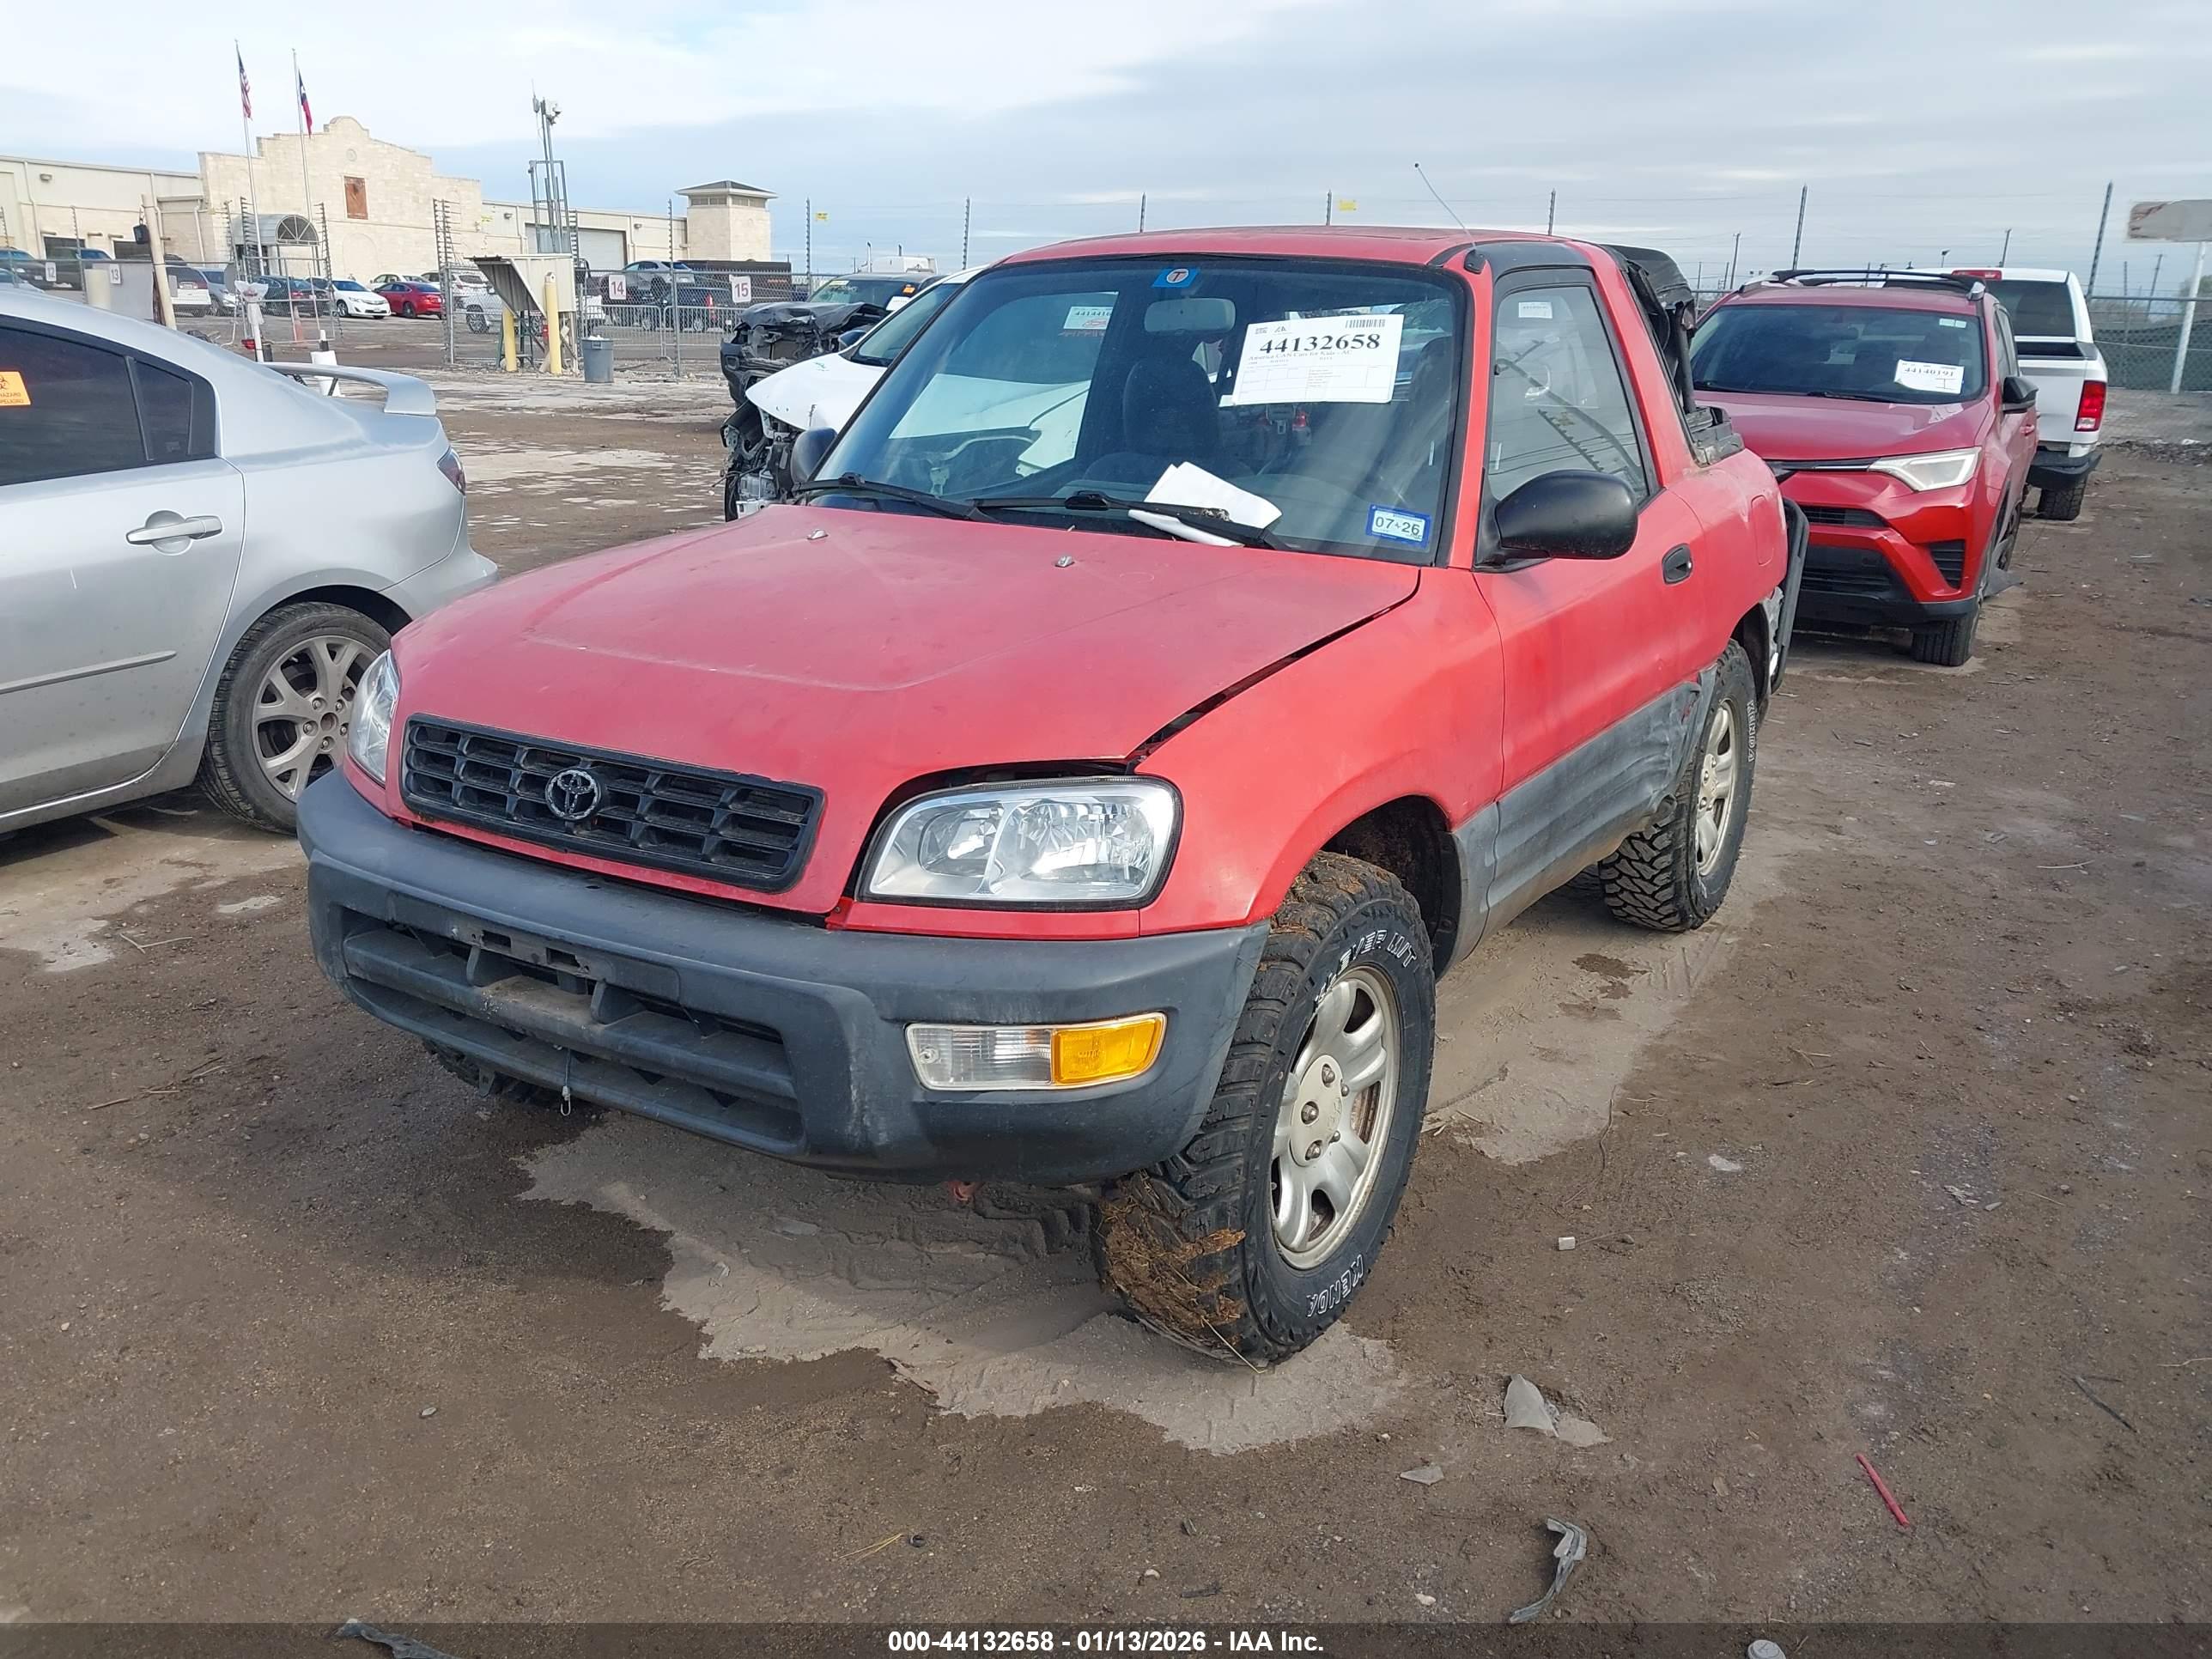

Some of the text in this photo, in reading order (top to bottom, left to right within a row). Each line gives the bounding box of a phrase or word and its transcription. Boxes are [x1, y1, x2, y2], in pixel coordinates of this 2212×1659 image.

[47, 267, 56, 278] 12
[110, 268, 119, 281] 13
[611, 281, 625, 295] 14
[734, 283, 749, 297] 15
[1260, 333, 1381, 354] 44132658
[1747, 699, 1756, 763] KENDA
[1306, 1254, 1364, 1317] KENDA
